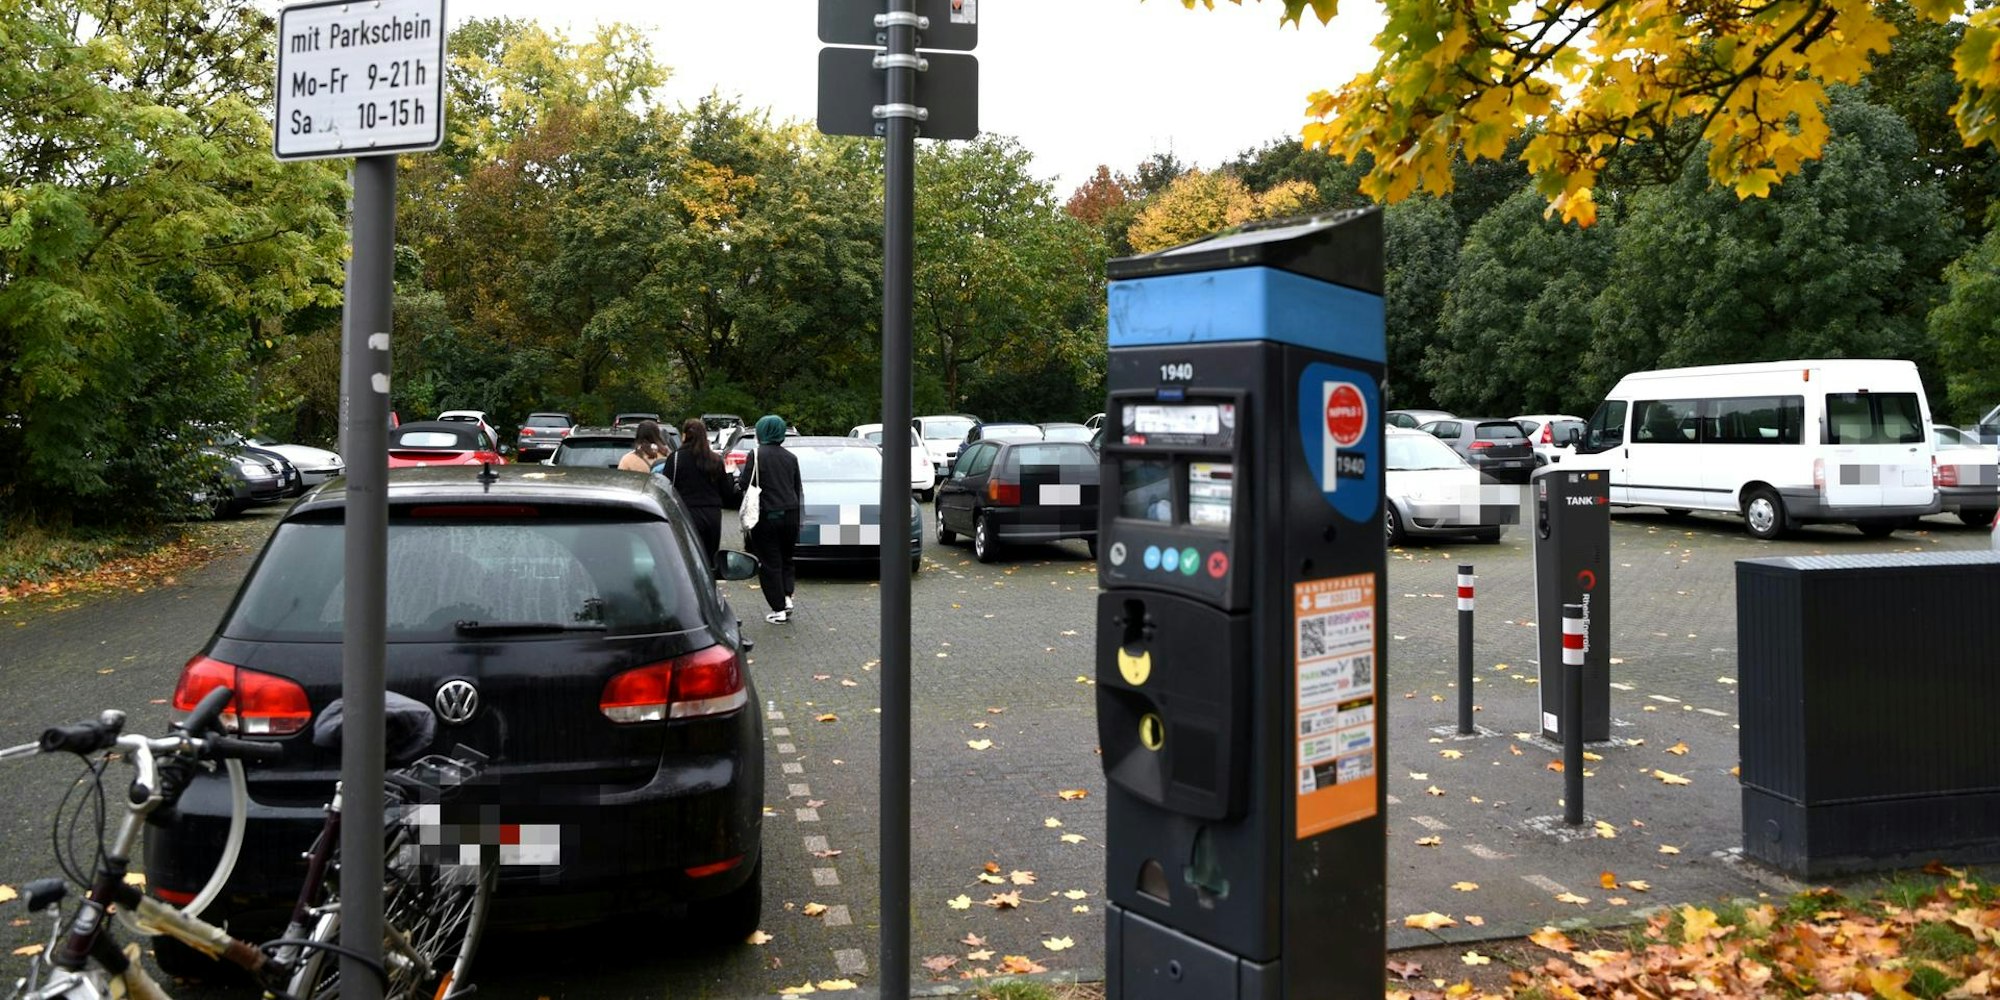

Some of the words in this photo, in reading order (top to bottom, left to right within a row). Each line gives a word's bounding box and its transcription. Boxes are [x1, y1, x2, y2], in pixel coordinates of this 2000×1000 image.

[291, 26, 320, 53] mit
[330, 13, 431, 49] Parkschein
[292, 67, 348, 98] Mo-Fr
[368, 60, 410, 90] 9-21
[415, 59, 426, 86] h
[291, 109, 312, 135] Sa
[357, 98, 409, 129] 10-15
[414, 98, 425, 125] h
[1160, 362, 1193, 381] 1940
[1337, 456, 1365, 475] 1940
